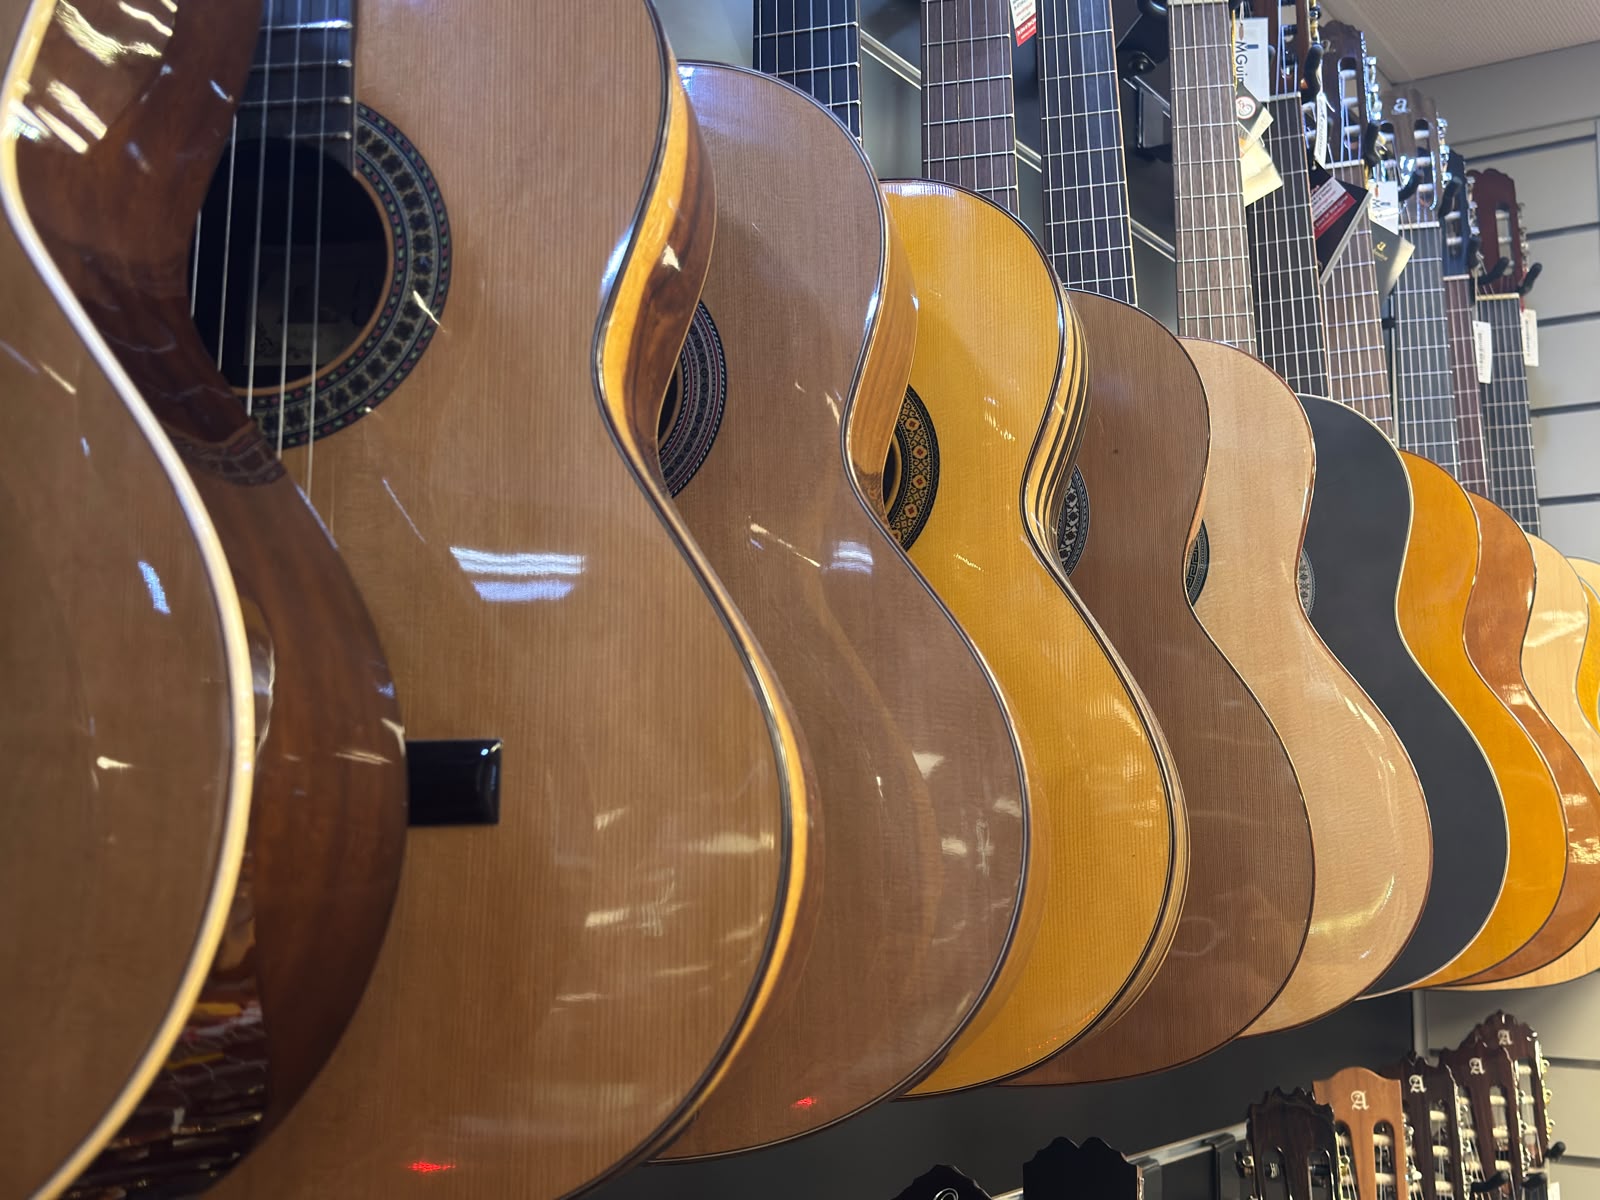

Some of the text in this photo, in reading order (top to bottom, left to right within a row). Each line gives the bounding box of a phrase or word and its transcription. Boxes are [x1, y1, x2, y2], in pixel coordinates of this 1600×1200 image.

[1497, 1029, 1513, 1046] A
[1469, 1057, 1485, 1075] A
[1408, 1074, 1427, 1094] A
[1350, 1090, 1370, 1111] A
